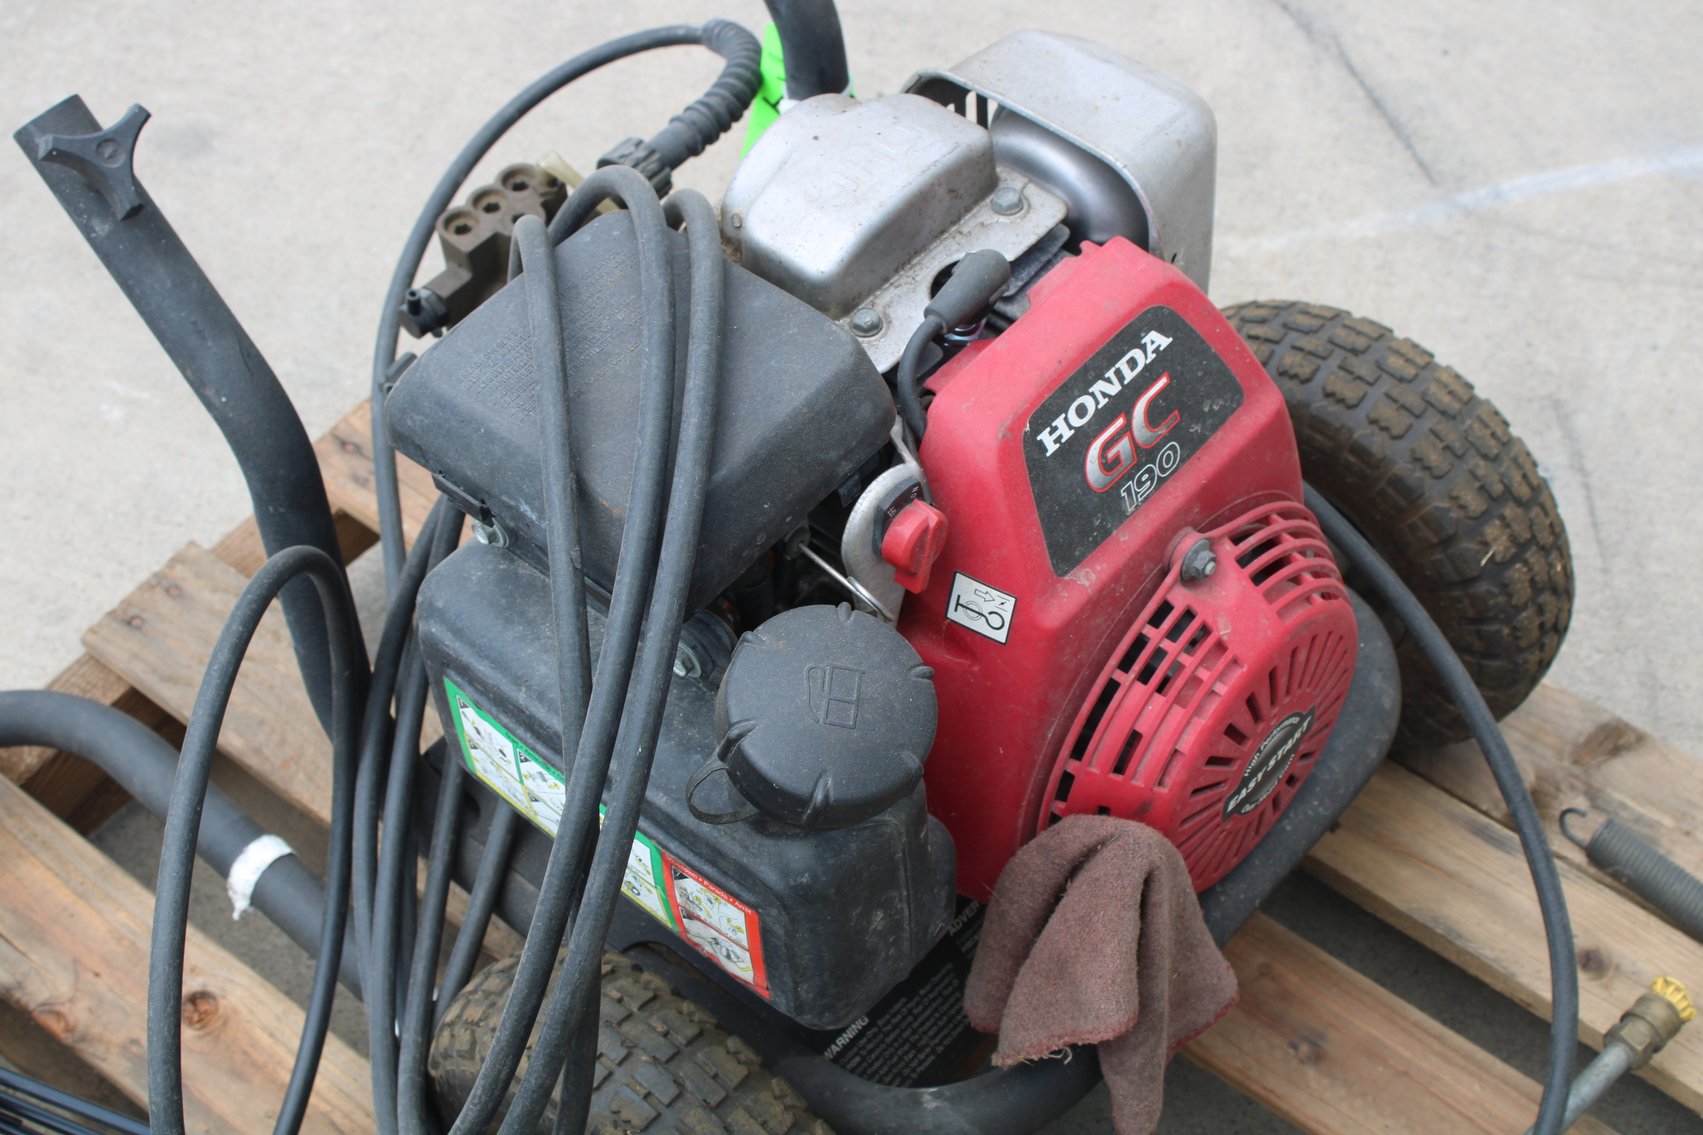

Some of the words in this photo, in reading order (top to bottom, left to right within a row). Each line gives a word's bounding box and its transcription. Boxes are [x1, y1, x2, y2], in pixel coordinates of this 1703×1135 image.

[1037, 330, 1173, 457] HONDA
[1085, 371, 1181, 493] GC
[1121, 441, 1181, 515] 190
[1226, 766, 1267, 813] EASY
[1266, 715, 1312, 771] START
[950, 900, 981, 937] ADVER
[823, 1015, 870, 1061] WARNING
